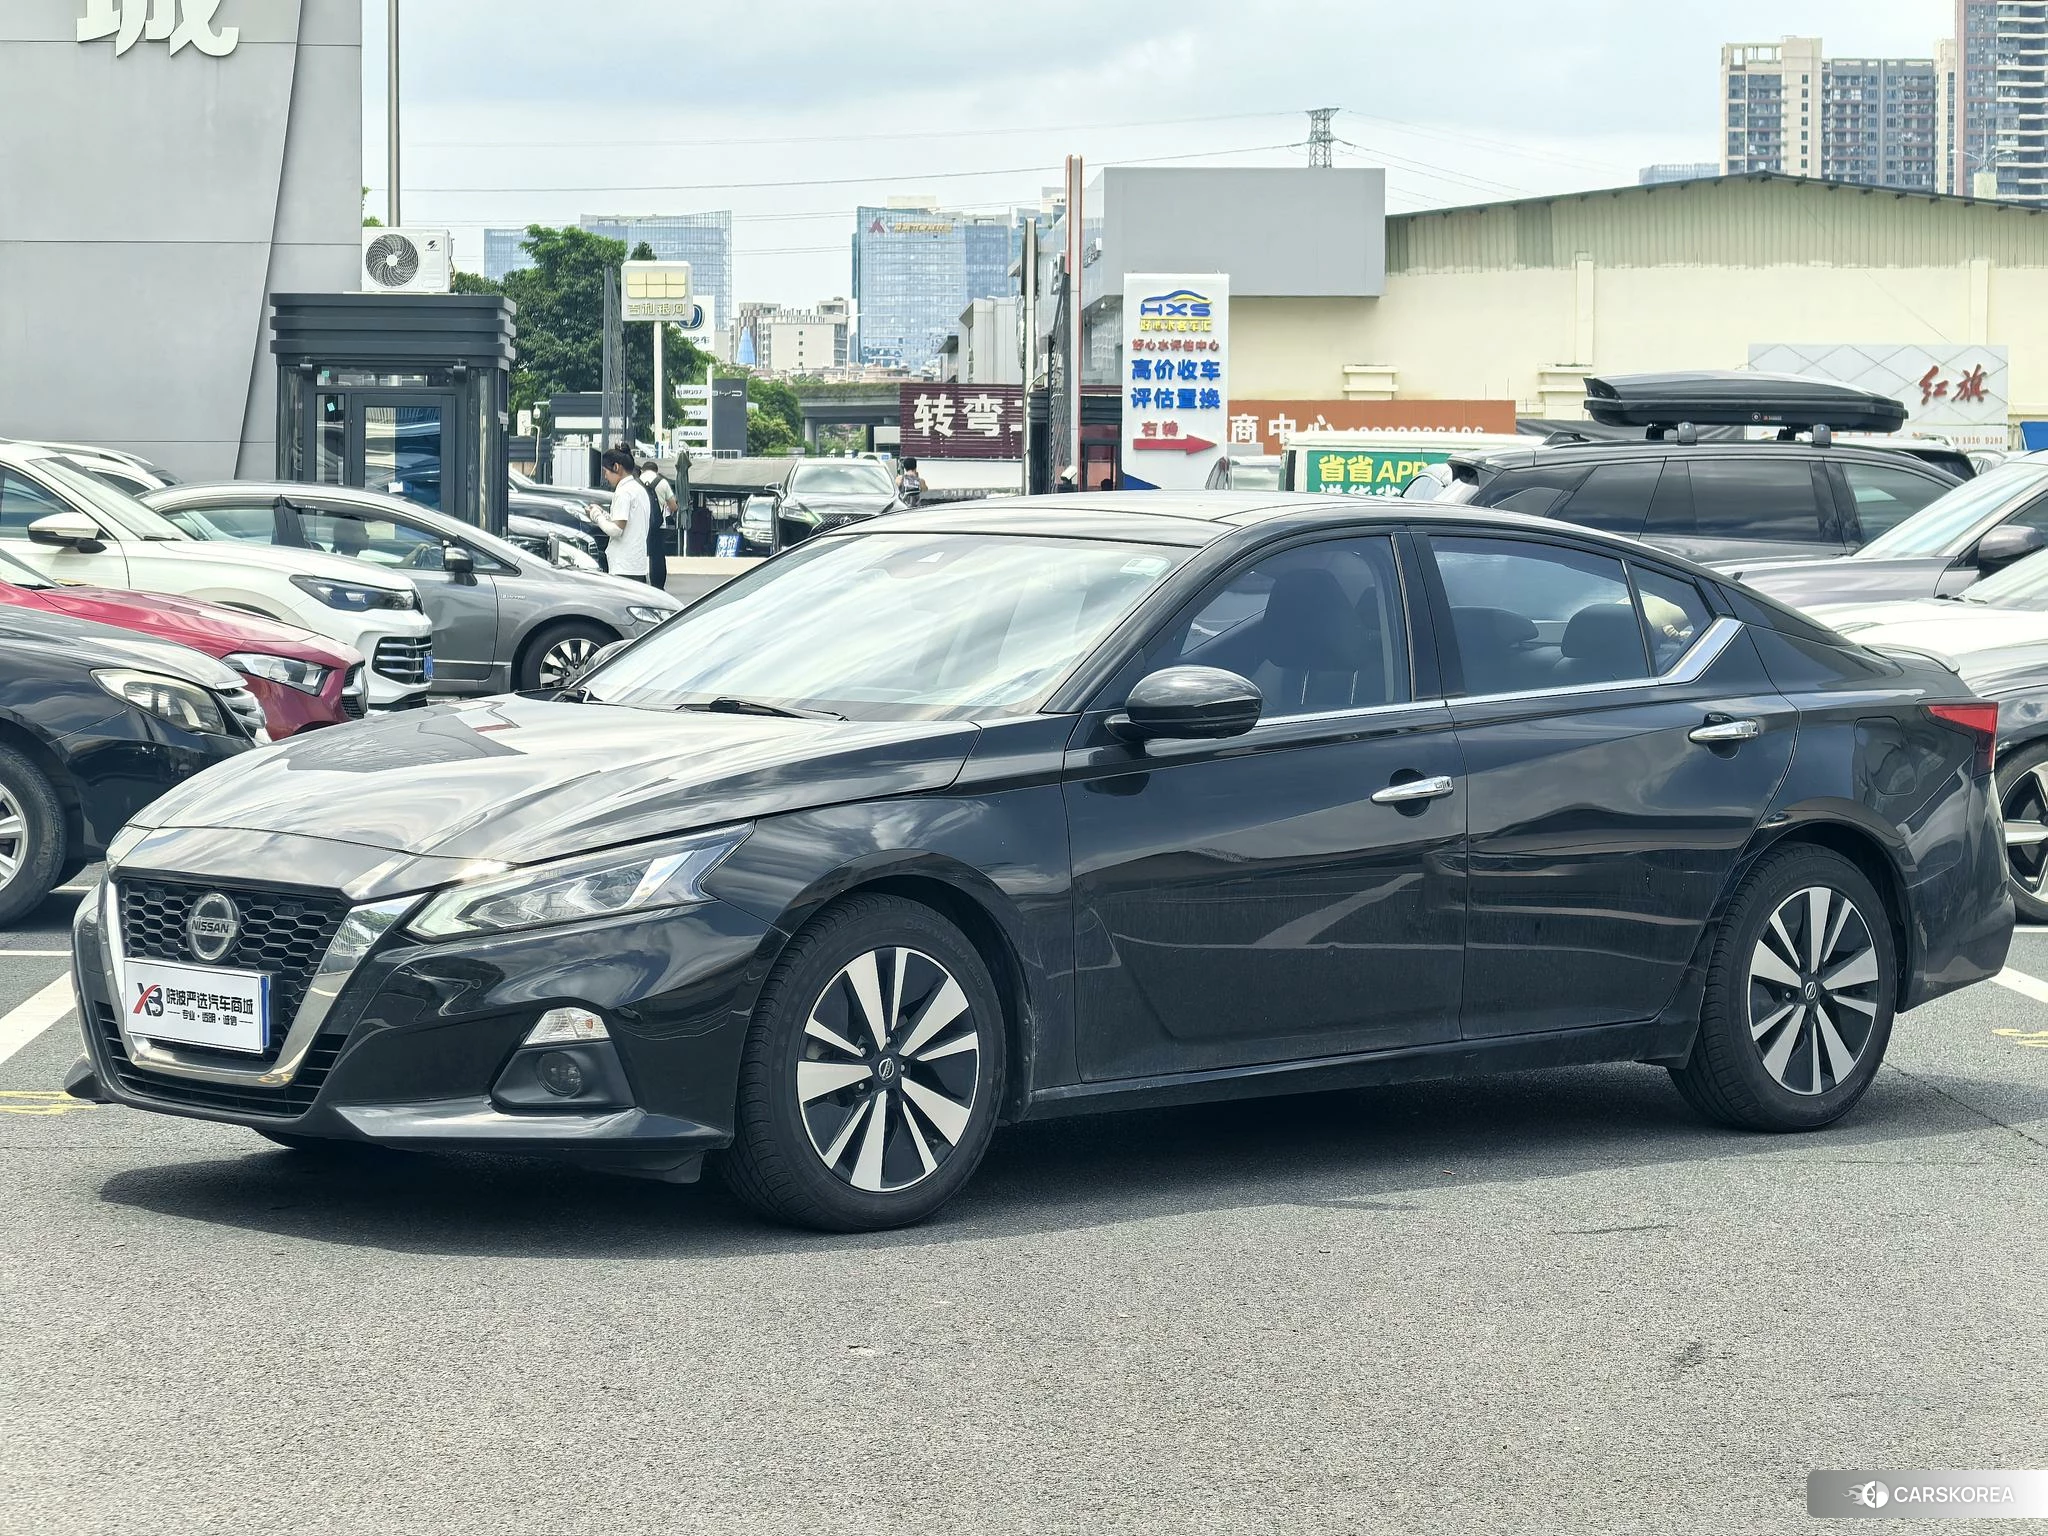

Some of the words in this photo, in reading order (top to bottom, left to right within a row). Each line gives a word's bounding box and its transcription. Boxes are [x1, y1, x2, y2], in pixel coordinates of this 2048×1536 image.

[628, 303, 686, 316] 吉利银河
[1140, 303, 1211, 317] HXS
[1132, 338, 1220, 352] 好心水评估中心
[1131, 358, 1221, 381] 高价收车
[1918, 363, 1990, 406] 红旗
[1130, 387, 1221, 410] 评估置换
[913, 393, 1023, 437] 转弯
[191, 919, 230, 934] NISSAN
